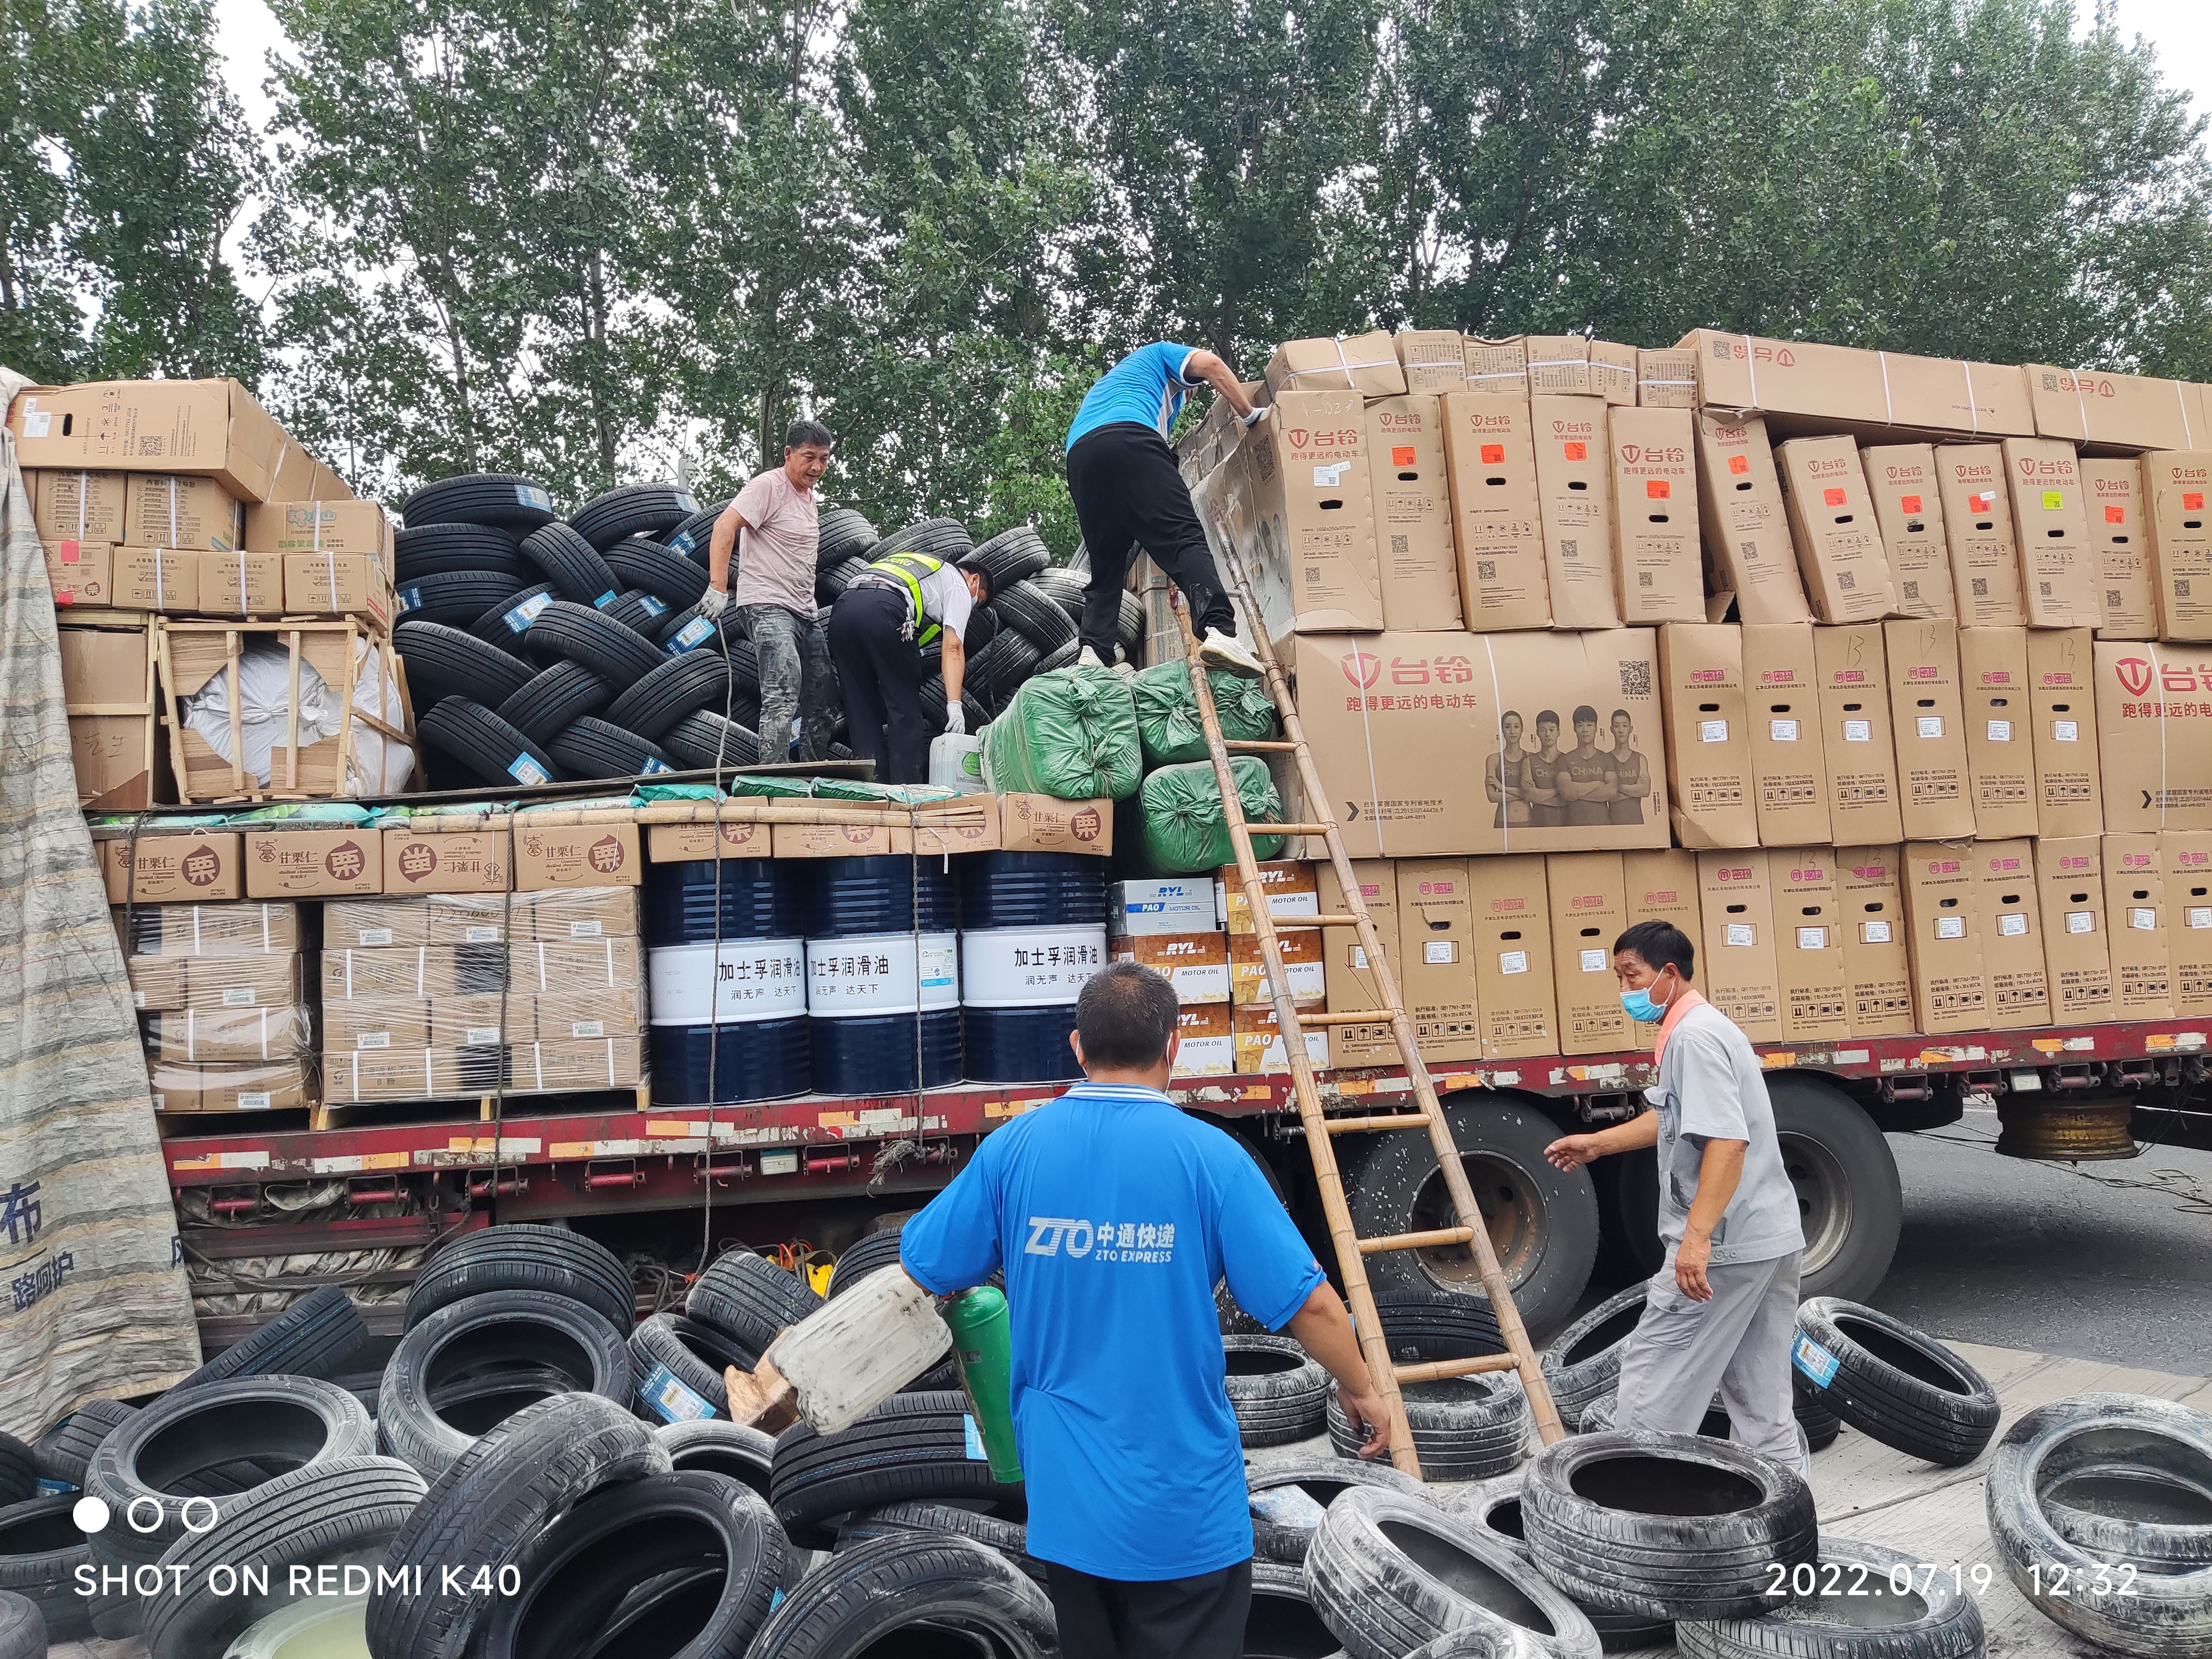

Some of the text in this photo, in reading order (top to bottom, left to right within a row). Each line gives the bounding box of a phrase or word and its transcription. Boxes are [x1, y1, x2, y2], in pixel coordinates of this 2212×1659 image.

[1395, 414, 1421, 425] 台铃
[1485, 415, 1510, 425] 台铃
[1567, 422, 1592, 432] 台铃
[1314, 429, 1358, 446] 台铃
[1291, 450, 1360, 460] 跑得更远的电动车
[1645, 447, 1684, 462] 台铃
[1822, 458, 1846, 470] 台铃
[1969, 465, 1991, 475] 台铃
[2039, 460, 2073, 474] 台铃
[1900, 466, 1922, 477] 台铃
[2185, 468, 2206, 478] 台铃
[2107, 480, 2129, 490] 台铃
[1391, 656, 1473, 685] 台铃
[1346, 693, 1478, 711] 跑得更远的电动车
[1572, 766, 1603, 775] CHINA
[1033, 812, 1066, 822] 甘栗仁
[1075, 814, 1098, 838] 栗
[279, 851, 319, 864] 甘栗仁
[546, 845, 581, 858] 甘栗仁
[593, 843, 620, 870] 栗
[137, 857, 175, 869] 甘栗仁
[331, 849, 361, 878] 栗
[403, 846, 432, 874] 栗
[186, 854, 216, 883] 栗
[444, 861, 482, 873] 甘栗仁
[1157, 886, 1184, 897] RYL
[1166, 942, 1196, 955] RYL
[1014, 945, 1098, 967] 加士孚润滑油
[719, 957, 800, 982] 加士孚润滑油
[811, 954, 889, 977] 加士孚润滑油
[1241, 964, 1266, 977] PAO
[1025, 973, 1095, 985] 润无声 达天下
[731, 985, 797, 1000] 润无声 达天下
[815, 985, 836, 995] 润无声
[1244, 1034, 1271, 1046] PAO
[1024, 1216, 1094, 1258] ZTO
[1097, 1222, 1175, 1249] 中通快递
[1095, 1250, 1172, 1263] ZTO EXPRESS
